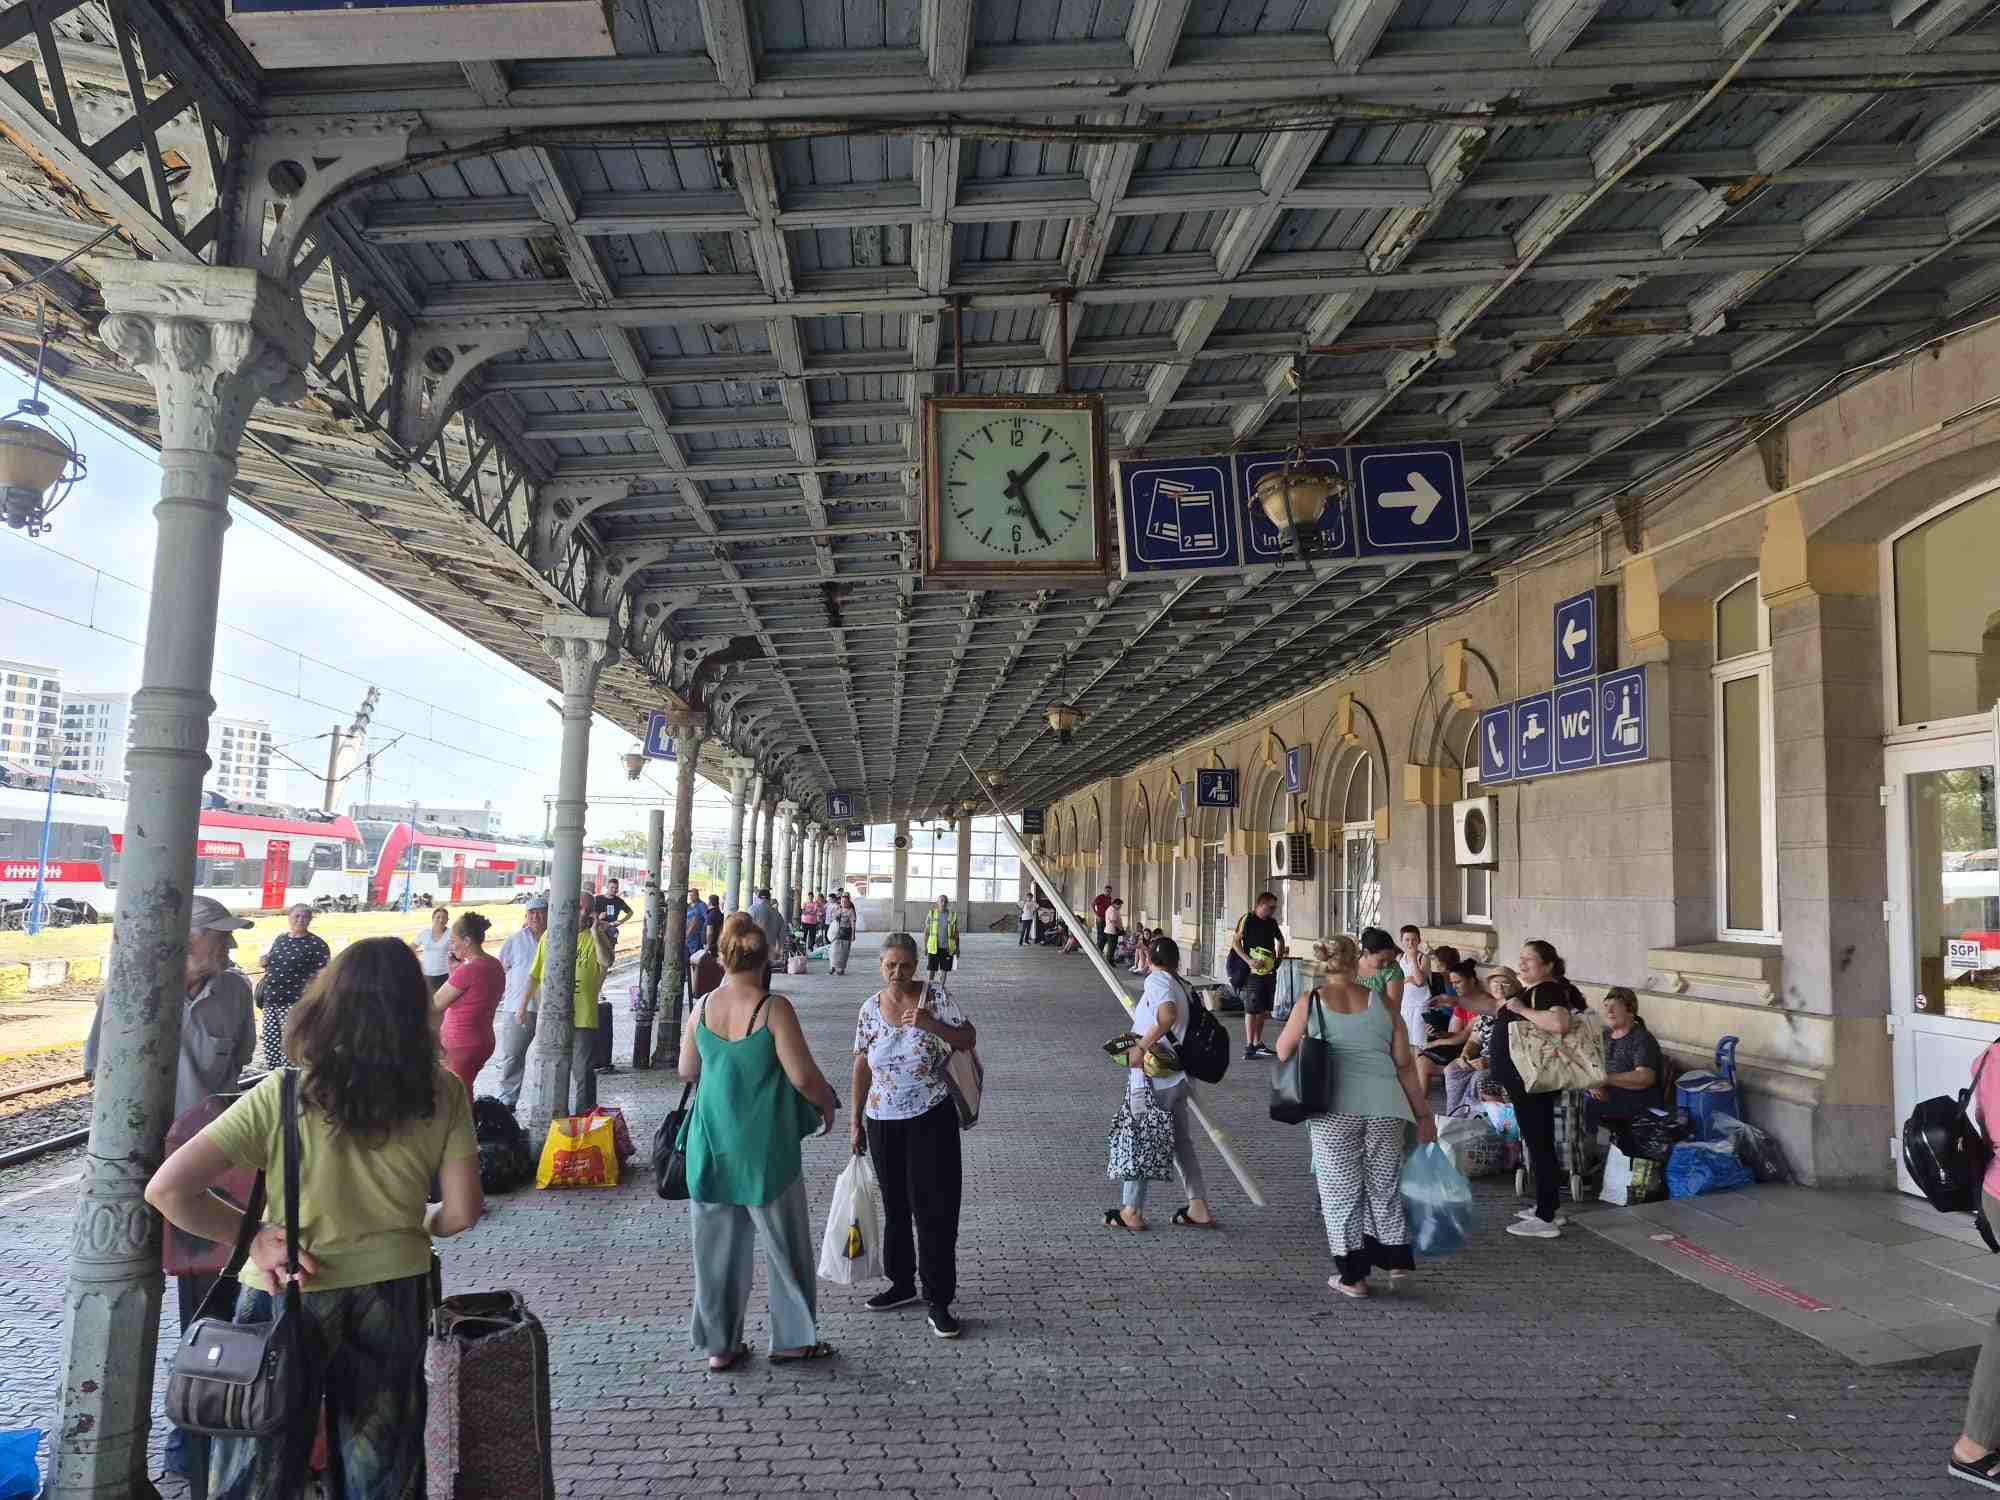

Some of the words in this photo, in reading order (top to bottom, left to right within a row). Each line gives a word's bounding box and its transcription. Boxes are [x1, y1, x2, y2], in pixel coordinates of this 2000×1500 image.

[1010, 430, 1024, 447] 12
[1011, 524, 1022, 542] 6
[1152, 521, 1160, 534] 1
[1184, 535, 1193, 548] 2
[1560, 709, 1591, 740] WC
[1950, 944, 1978, 957] SGPI
